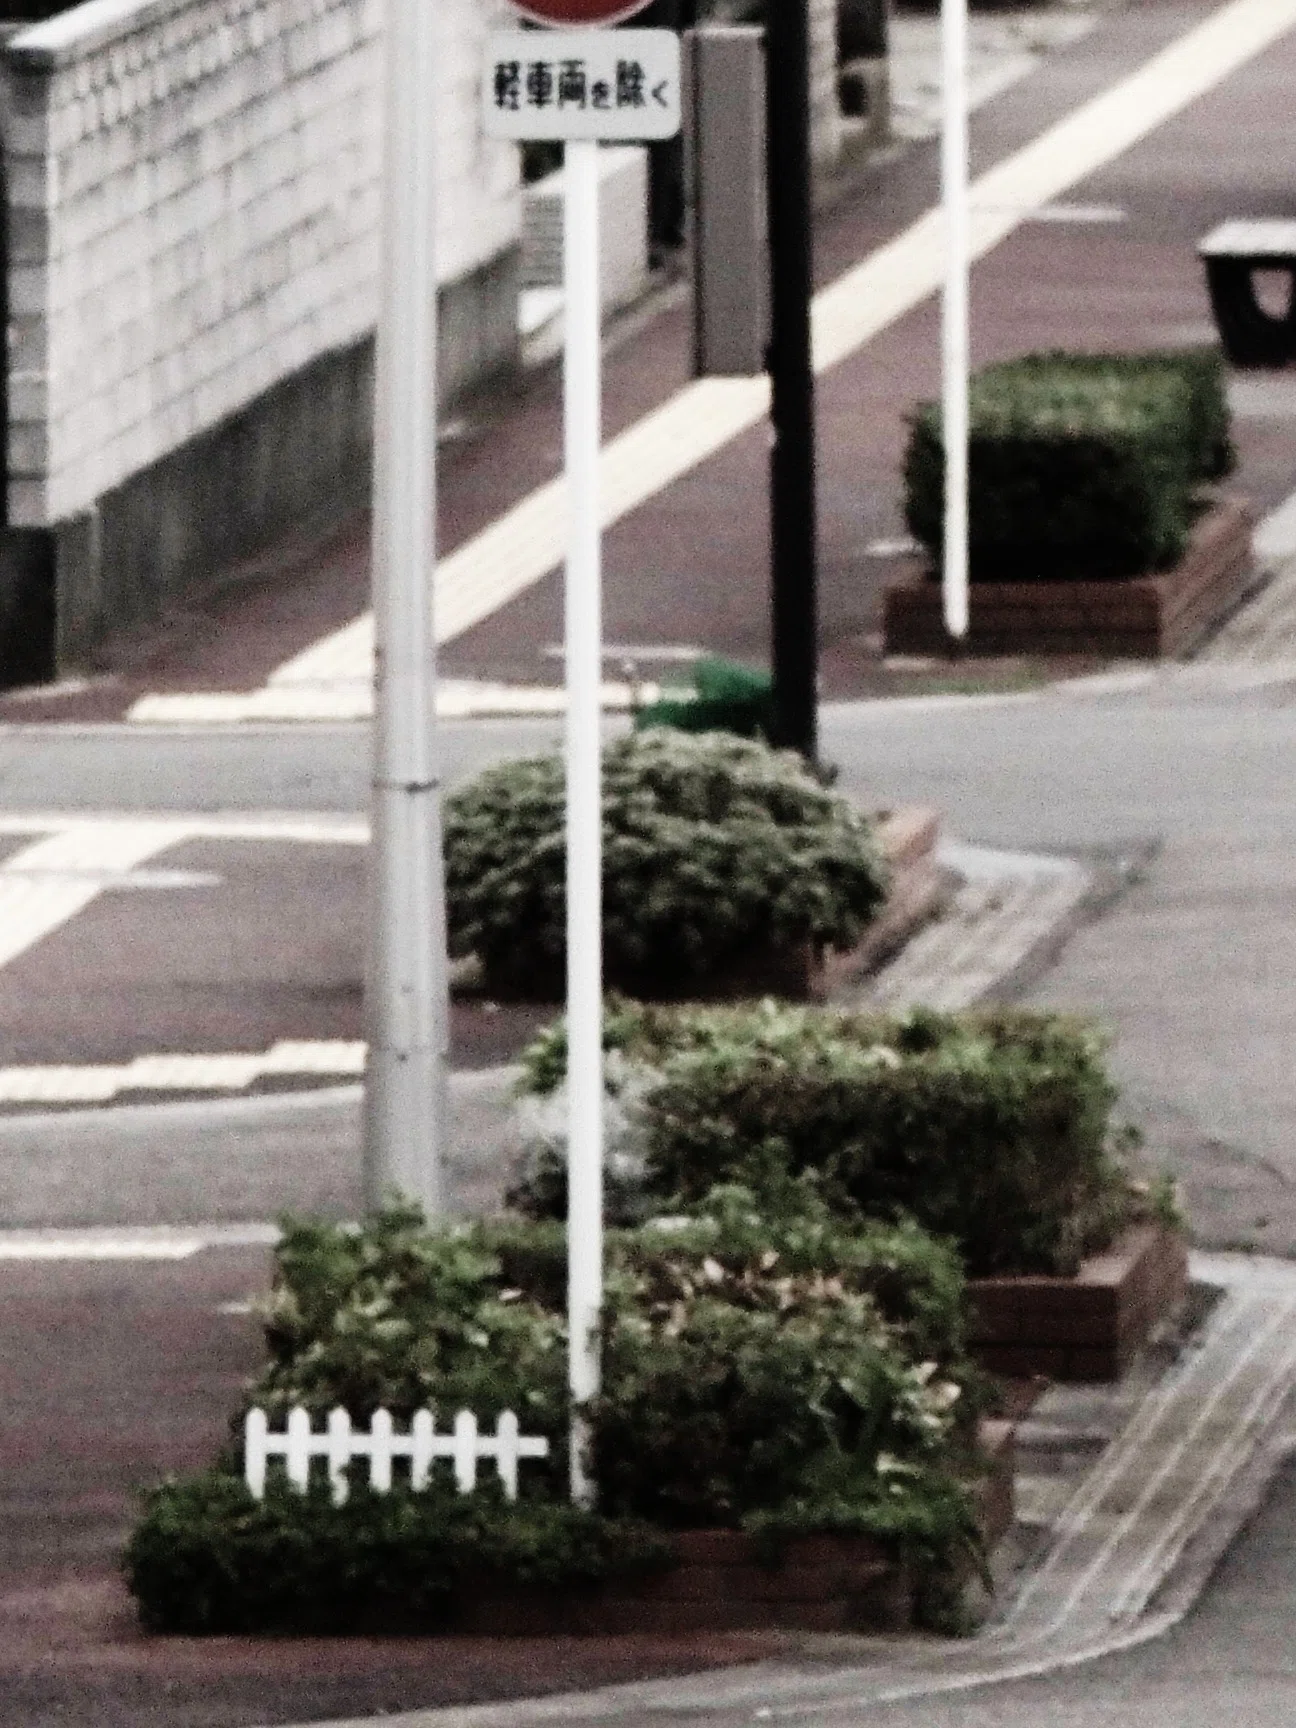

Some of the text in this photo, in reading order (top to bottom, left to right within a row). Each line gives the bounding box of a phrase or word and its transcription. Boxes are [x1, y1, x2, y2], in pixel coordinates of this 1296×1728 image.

[493, 58, 669, 111] 軽車両を除く
